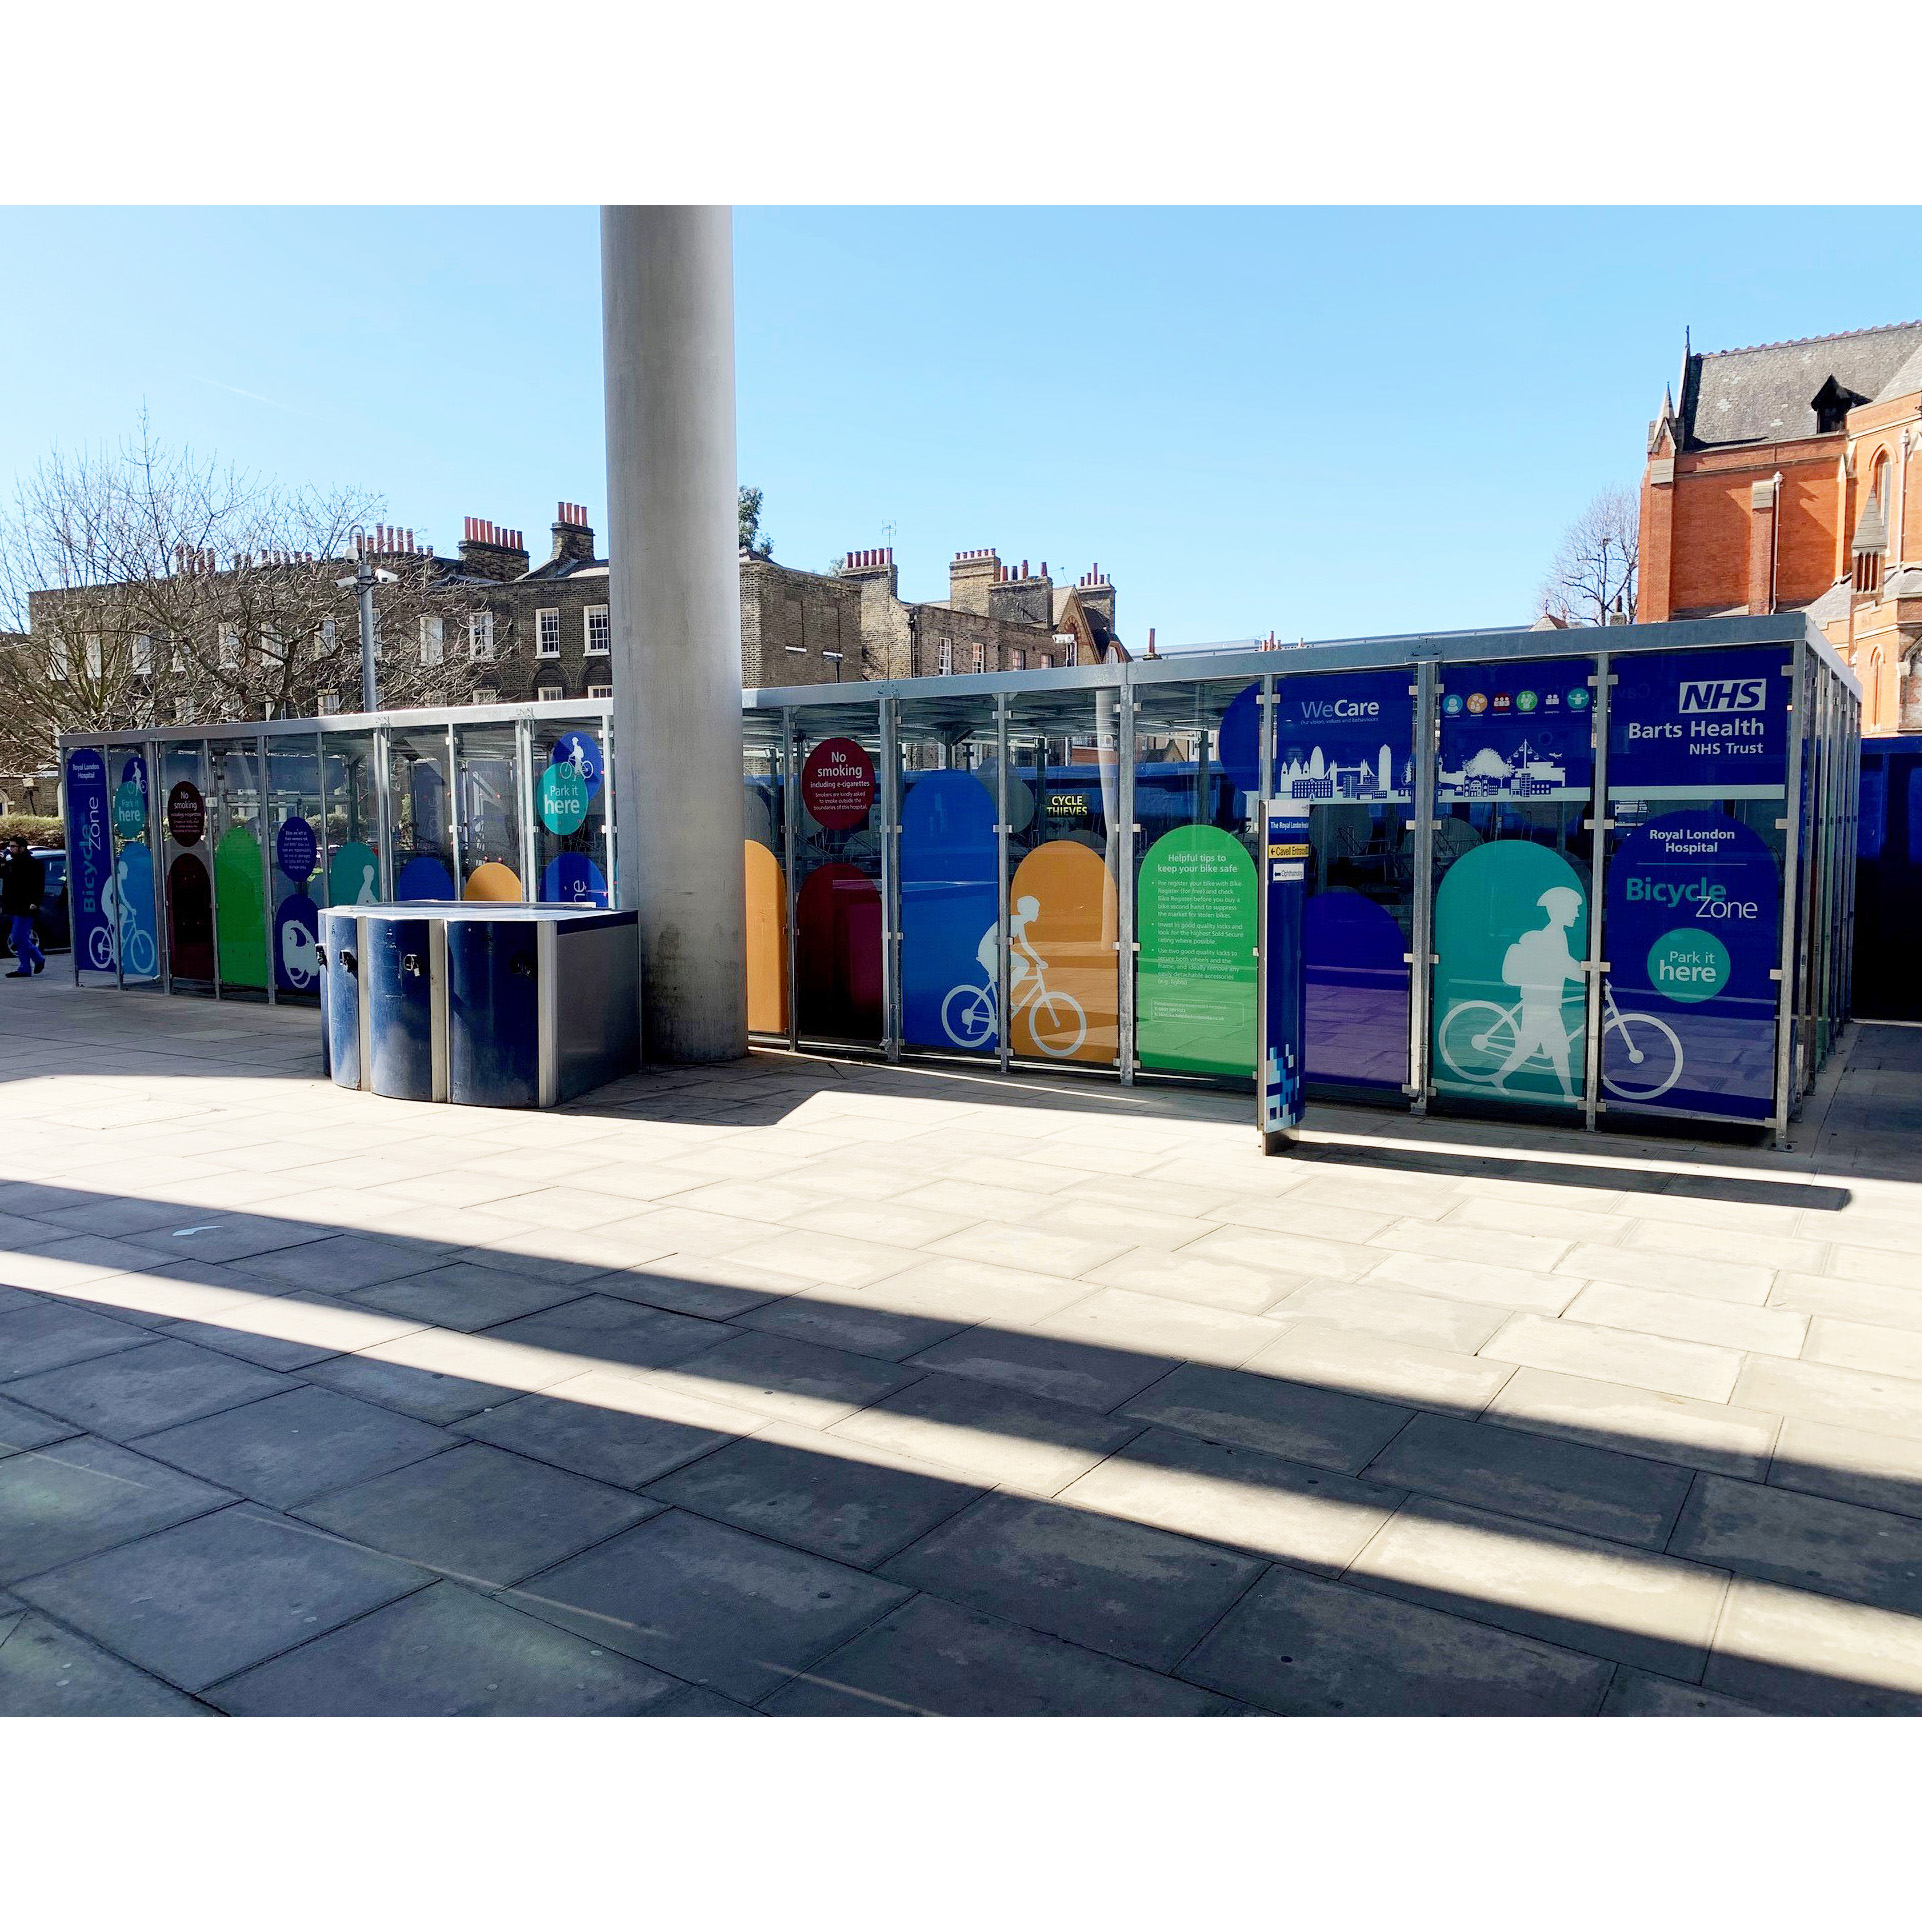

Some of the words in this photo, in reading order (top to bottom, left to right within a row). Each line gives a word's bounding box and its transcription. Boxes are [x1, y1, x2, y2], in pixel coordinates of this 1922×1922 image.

[1682, 681, 1763, 711] NHS
[1302, 699, 1379, 718] WeCare
[1629, 722, 1682, 739] Barts
[1691, 718, 1764, 737] Health
[1689, 743, 1720, 755] NHS
[1726, 742, 1763, 754] Trust
[831, 752, 846, 762] No
[818, 764, 862, 778] smoking
[181, 791, 189, 799] No
[550, 785, 570, 796] Park
[572, 785, 578, 796] it
[174, 801, 197, 811] smoking
[544, 794, 580, 814] here
[1052, 796, 1082, 805] CYCLE
[118, 807, 140, 822] here
[1047, 807, 1087, 816] THIEVES
[89, 797, 100, 850] Zone
[1280, 821, 1290, 830] Royal
[1650, 829, 1683, 842] Royal
[1687, 829, 1735, 839] London
[1276, 847, 1291, 856] Cavell
[1666, 842, 1718, 855] Hospital
[1168, 854, 1198, 863] Helpful
[1200, 854, 1215, 863] tips
[79, 824, 97, 912] Bicycle
[1157, 864, 1177, 873] keep
[1179, 865, 1198, 874] your
[1200, 864, 1218, 872] bike
[1220, 864, 1238, 872] safe
[573, 880, 586, 903] ne
[1626, 877, 1726, 908] Bicycle
[1696, 896, 1758, 919] Zone
[1669, 951, 1700, 963] Park
[1705, 952, 1715, 963] it
[1659, 960, 1716, 982] here
